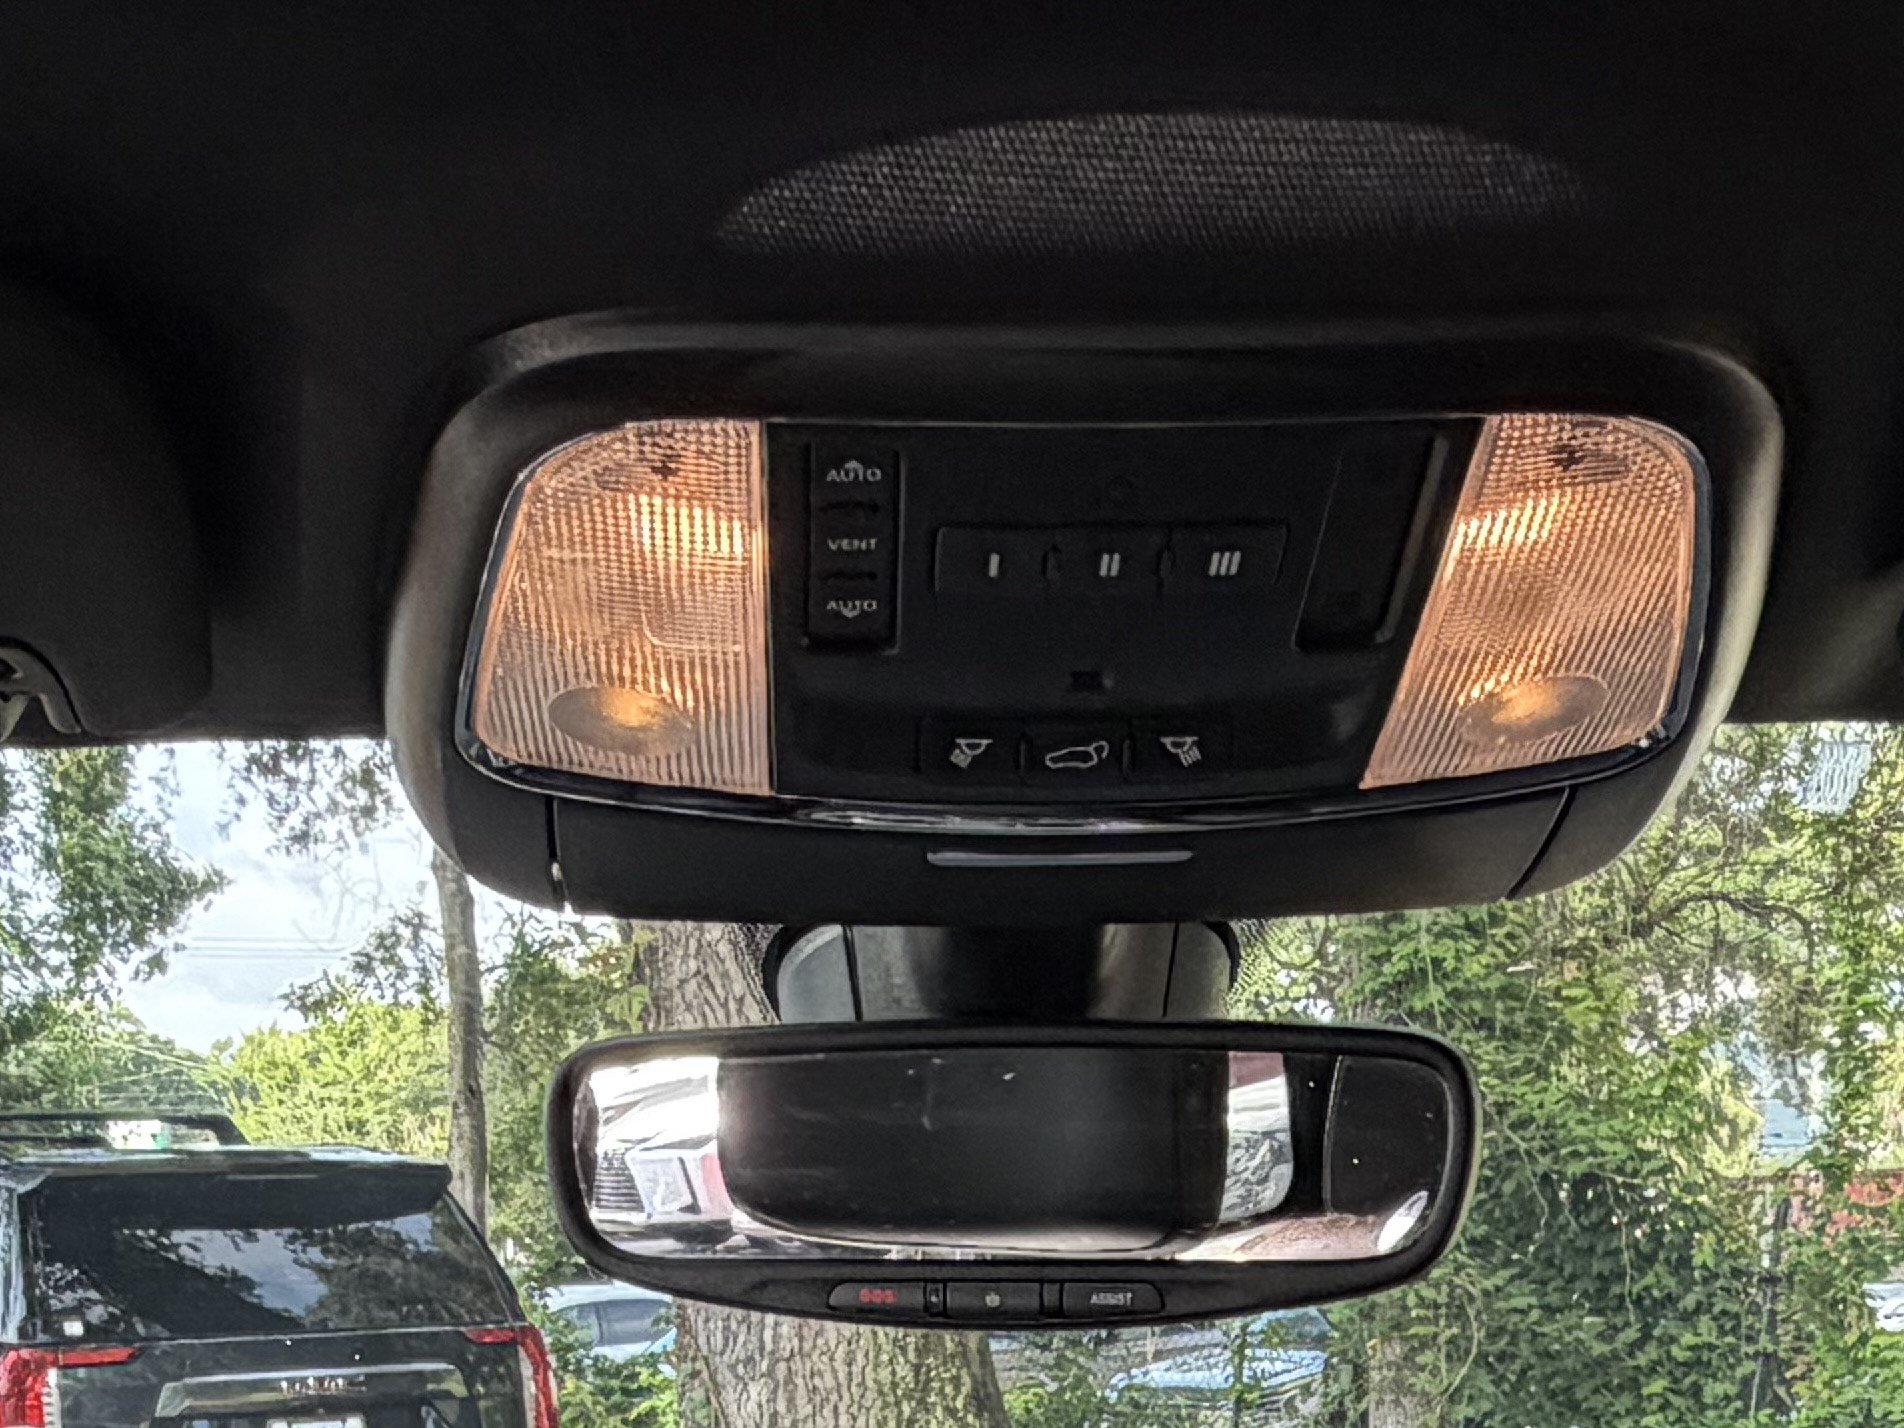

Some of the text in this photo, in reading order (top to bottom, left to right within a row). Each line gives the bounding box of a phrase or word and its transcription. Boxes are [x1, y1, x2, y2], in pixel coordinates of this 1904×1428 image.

[826, 467, 882, 482] AUTO
[827, 538, 878, 551] VENT
[826, 599, 878, 613] AUTO
